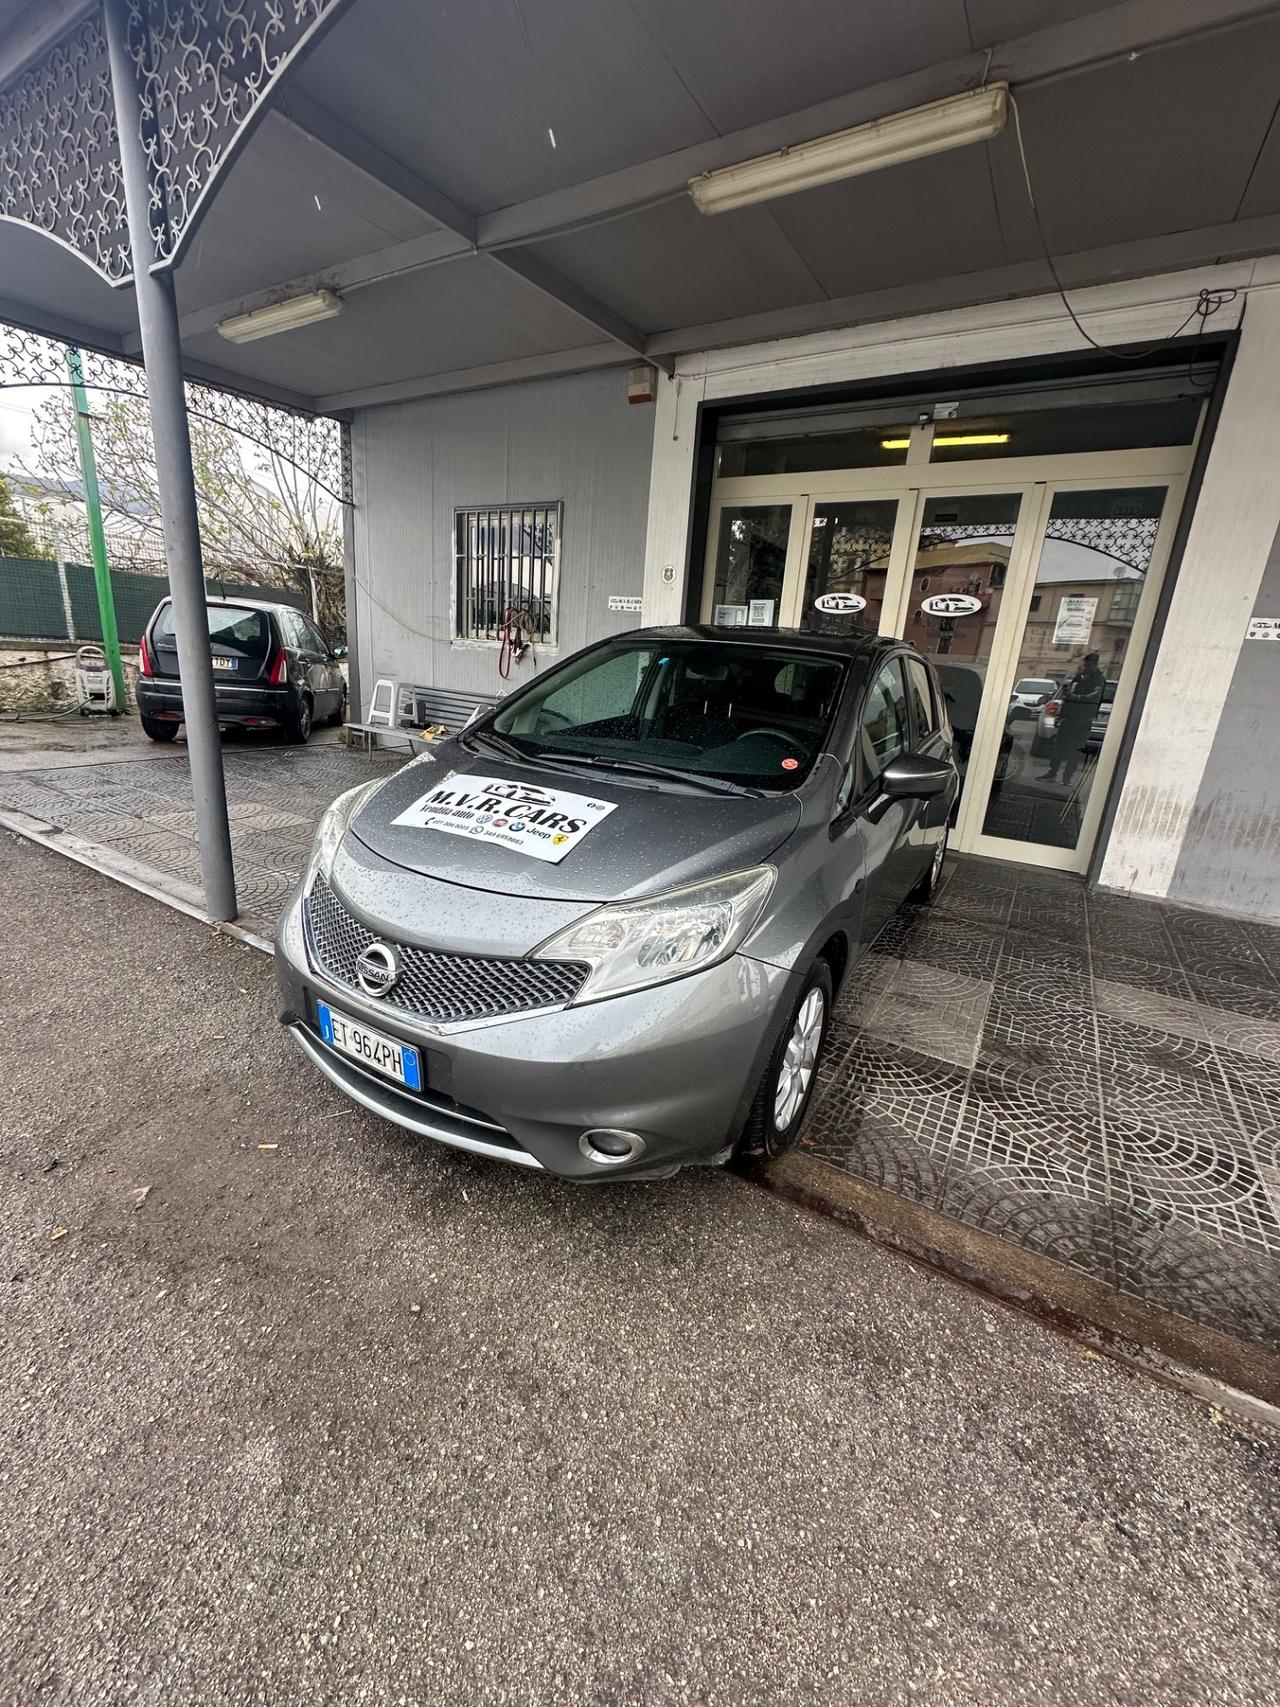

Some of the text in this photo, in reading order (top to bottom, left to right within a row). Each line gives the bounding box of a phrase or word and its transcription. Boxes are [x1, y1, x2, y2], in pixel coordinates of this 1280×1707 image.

[420, 804, 475, 819] Vendita auto
[526, 827, 551, 840] Jeep
[331, 1018, 403, 1076] ET 964PH
